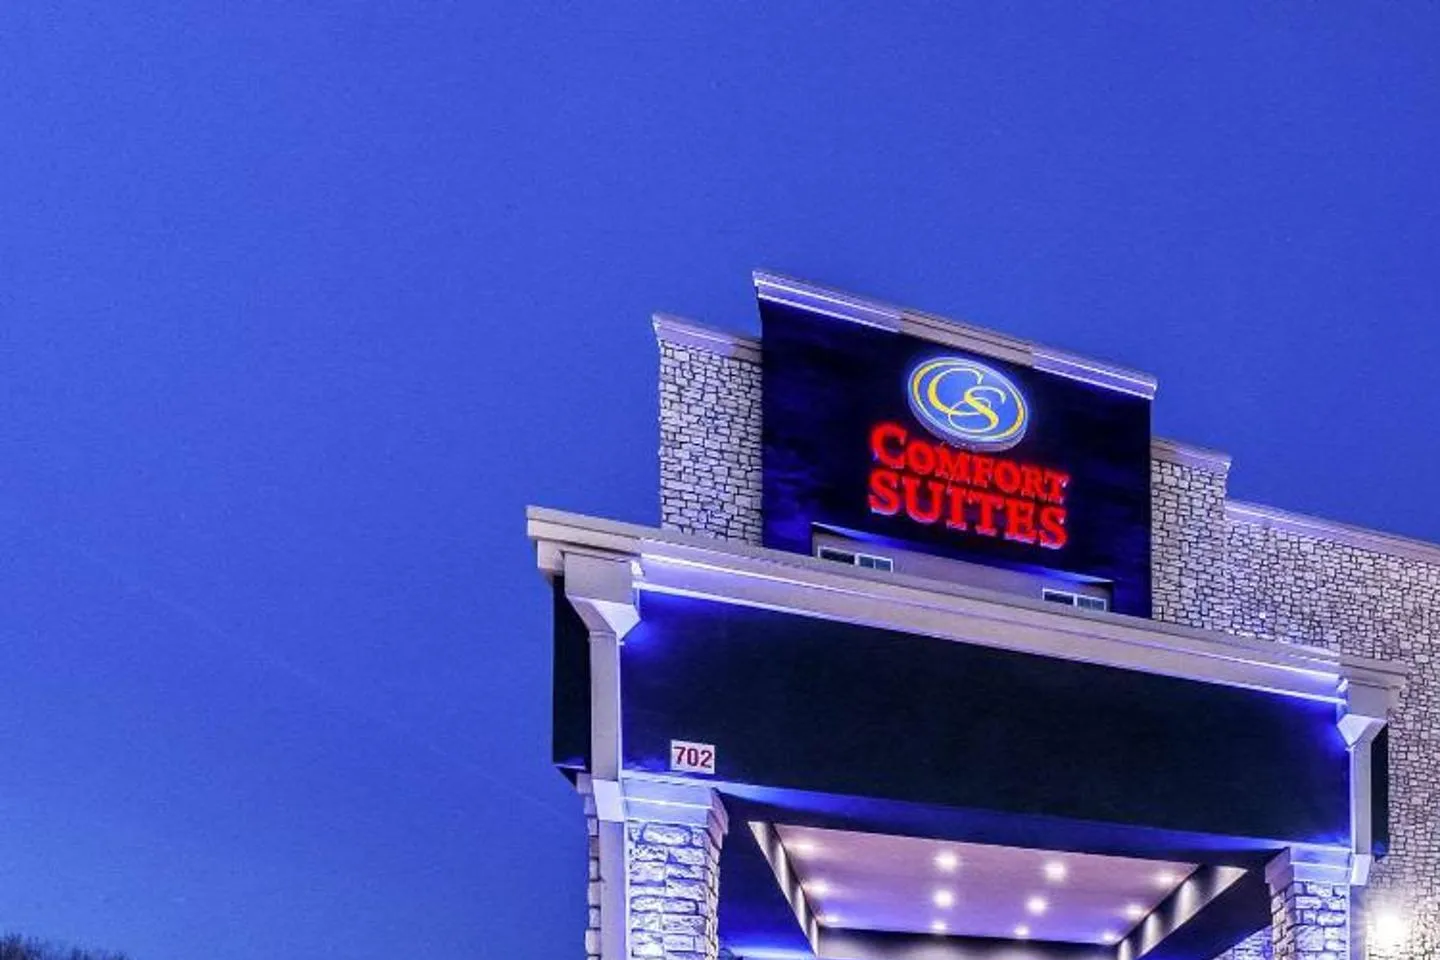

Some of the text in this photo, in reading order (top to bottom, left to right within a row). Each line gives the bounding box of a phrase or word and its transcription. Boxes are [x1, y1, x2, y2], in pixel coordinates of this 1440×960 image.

[869, 423, 1069, 504] COMFORT
[869, 468, 1068, 549] SUITES
[673, 746, 713, 768] 702
